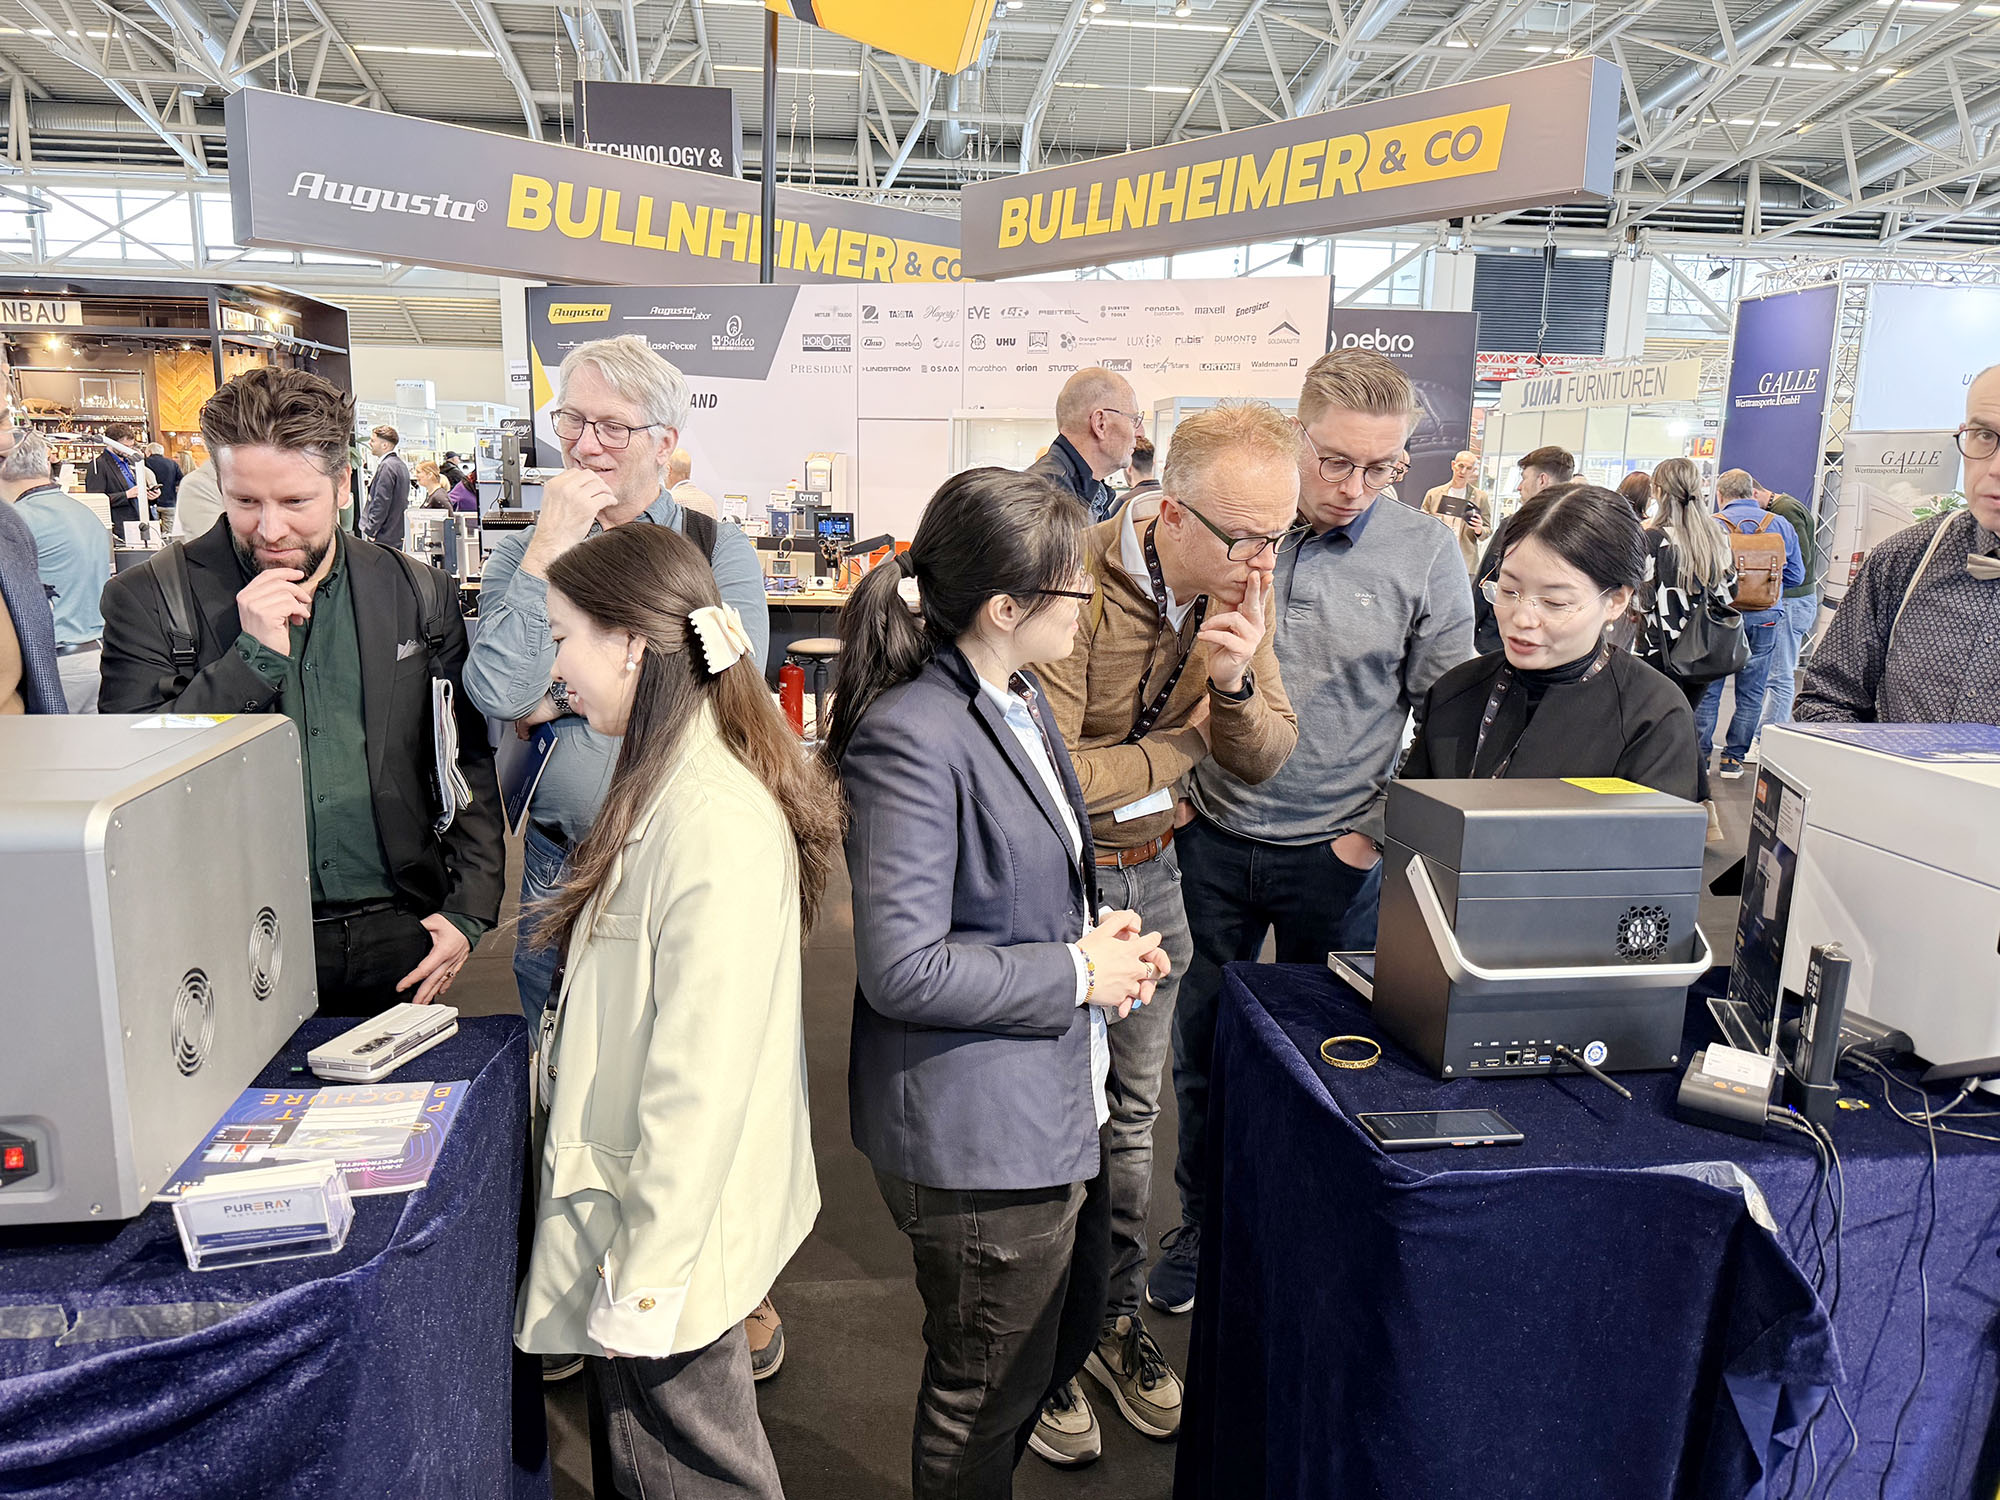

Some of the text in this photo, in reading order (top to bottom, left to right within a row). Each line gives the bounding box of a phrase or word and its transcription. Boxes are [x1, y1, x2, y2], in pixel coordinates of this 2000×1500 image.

[708, 148, 724, 168] &
[998, 125, 1483, 249] BULLNHEIMER & CO
[506, 173, 962, 283] BULLNHEIMER & CO
[967, 306, 990, 320] EVE
[1194, 305, 1225, 315] maxell
[1235, 300, 1270, 317] Energizer
[692, 312, 712, 321] Labor
[721, 333, 755, 347] Badeco
[996, 338, 1016, 347] UHU
[791, 364, 853, 374] PRESIDIUM
[968, 364, 1007, 372] marathon
[1016, 363, 1038, 372] orion
[1521, 366, 1667, 408] SUMA FURNITUREN
[1759, 369, 1819, 396] GALLE
[1780, 395, 1800, 405] GmbH
[1881, 451, 1941, 468] GALLE
[800, 492, 819, 502] OTEC
[260, 1086, 453, 1106] BROCHURE
[223, 1199, 292, 1214] PURERAY
